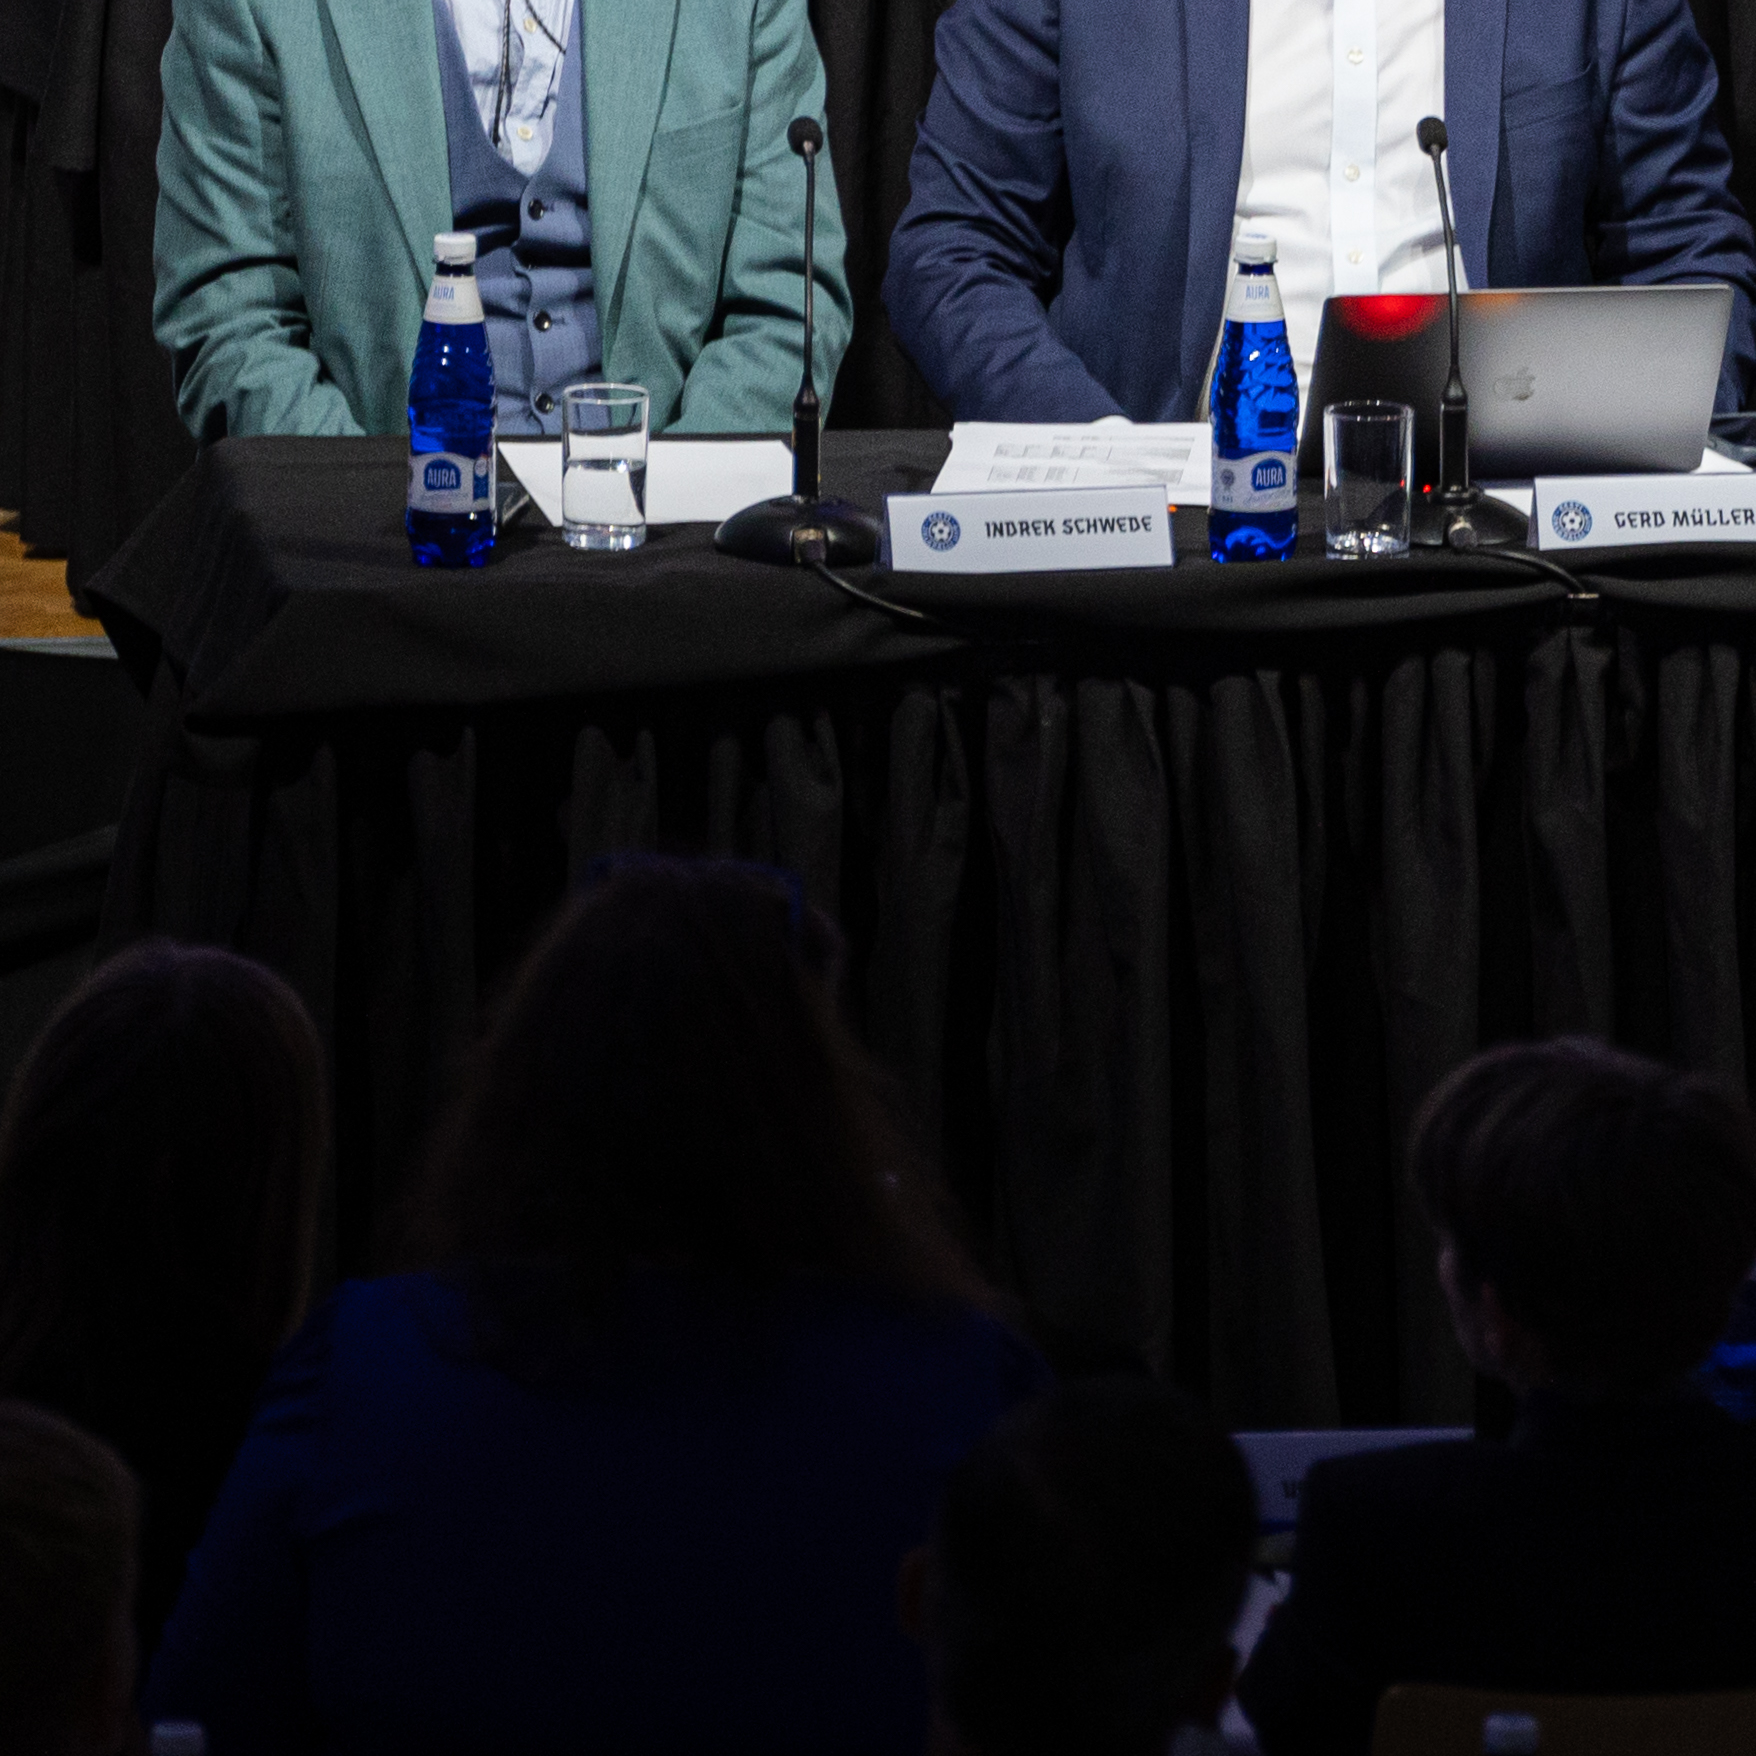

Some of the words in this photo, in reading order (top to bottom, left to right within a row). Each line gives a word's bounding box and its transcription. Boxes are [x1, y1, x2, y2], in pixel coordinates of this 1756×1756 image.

[432, 287, 455, 300] AURA
[1245, 286, 1270, 300] AURA
[427, 468, 456, 486] AURA
[1256, 467, 1283, 486] AURA
[985, 519, 1055, 538] INDREK
[1062, 515, 1152, 536] SCHWEDE
[1615, 510, 1666, 529] GERD
[1674, 507, 1756, 528] MÜLLER
